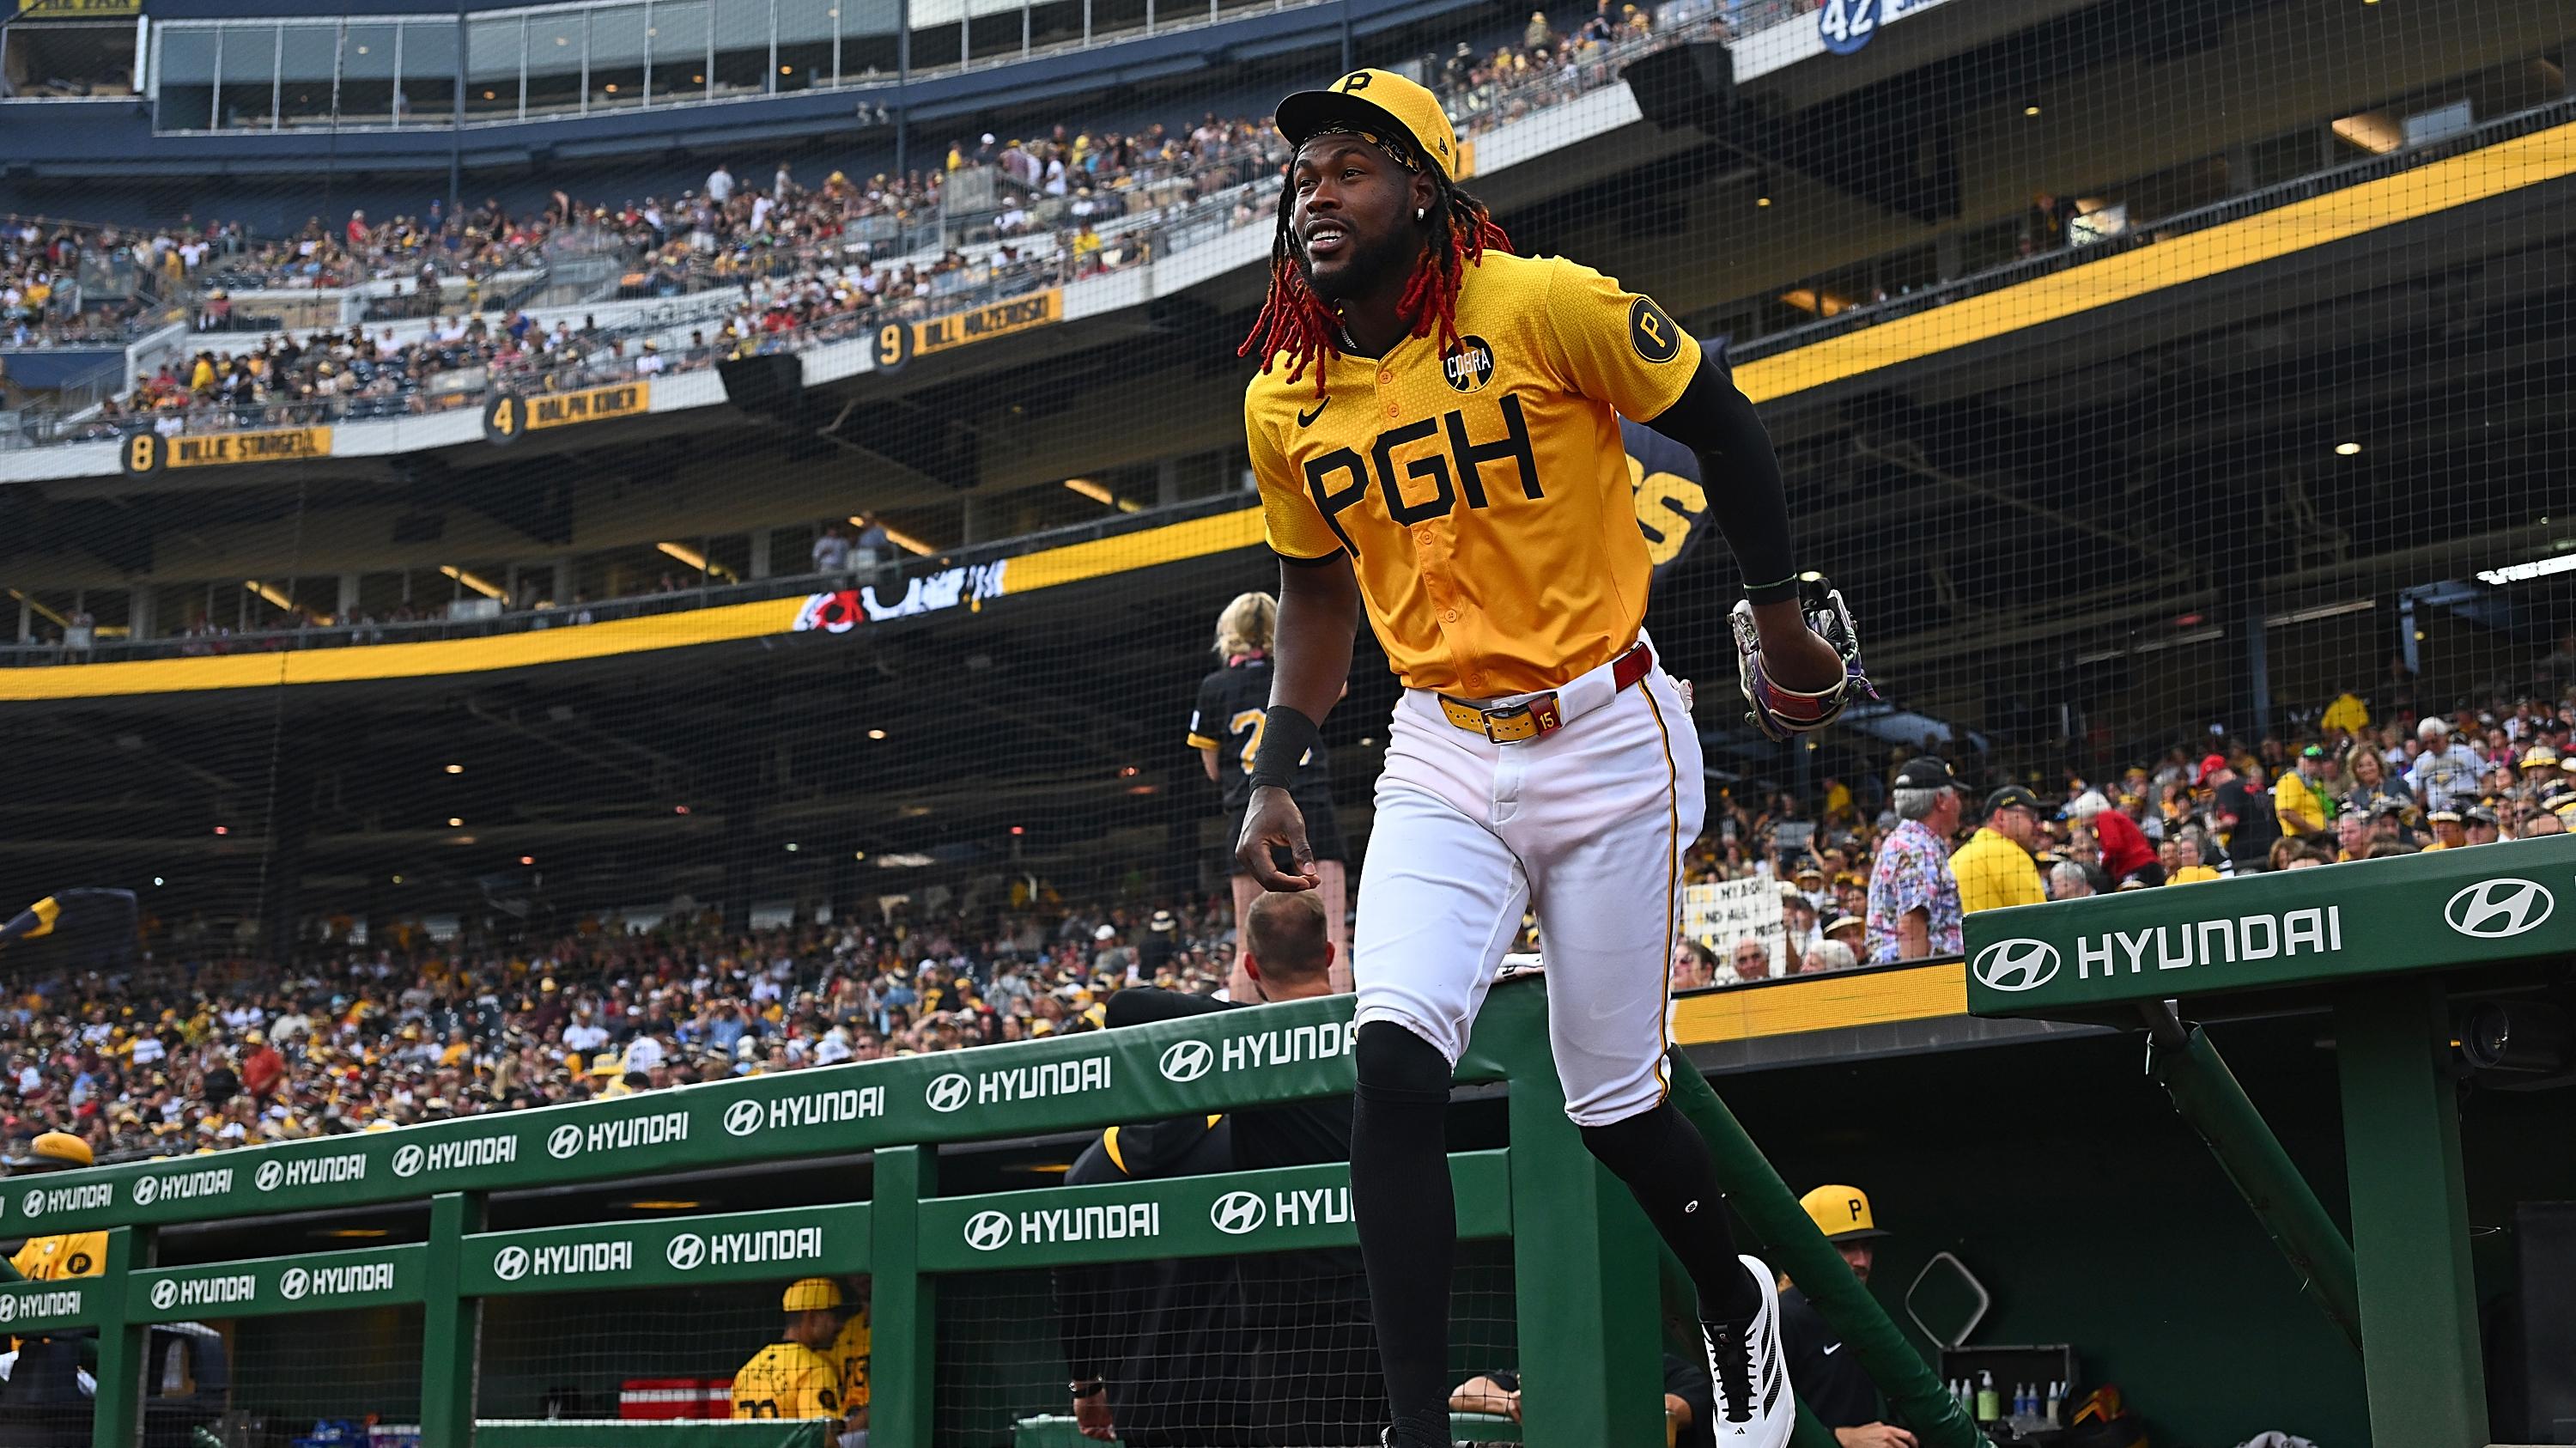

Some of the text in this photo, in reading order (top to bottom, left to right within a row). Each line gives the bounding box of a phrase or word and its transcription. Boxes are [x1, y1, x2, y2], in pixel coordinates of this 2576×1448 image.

[1821, 0, 1874, 41] 42
[1342, 72, 1372, 94] P
[880, 324, 901, 366] 9
[1640, 312, 1665, 348] P
[1447, 348, 1491, 378] COBRA
[493, 398, 513, 435] 4
[131, 434, 154, 472] 8
[1304, 392, 1545, 558] PGH
[1540, 712, 1554, 730] 15
[2078, 905, 2342, 979] HYUNDAI
[1223, 1020, 1357, 1072] HYUNDA
[978, 1056, 1111, 1104] HYUNDAI
[769, 1086, 884, 1129] HYUNDAI
[586, 1111, 689, 1153] HYUNDAI
[285, 1153, 367, 1186] HYUNDAI
[428, 1135, 517, 1171] HYUNDAI
[47, 1183, 113, 1213] HYUNDAI
[160, 1169, 234, 1201] HYUNDAI
[1020, 1202, 1159, 1244] HYUNDAI
[1848, 1199, 1862, 1221] P
[533, 1240, 633, 1275] HYUNDAI
[712, 1226, 822, 1265] HYUNDAI
[180, 1275, 256, 1305] HYUNDAI
[313, 1262, 394, 1295] HYUNDAI
[19, 1291, 82, 1318] HYUNDAI
